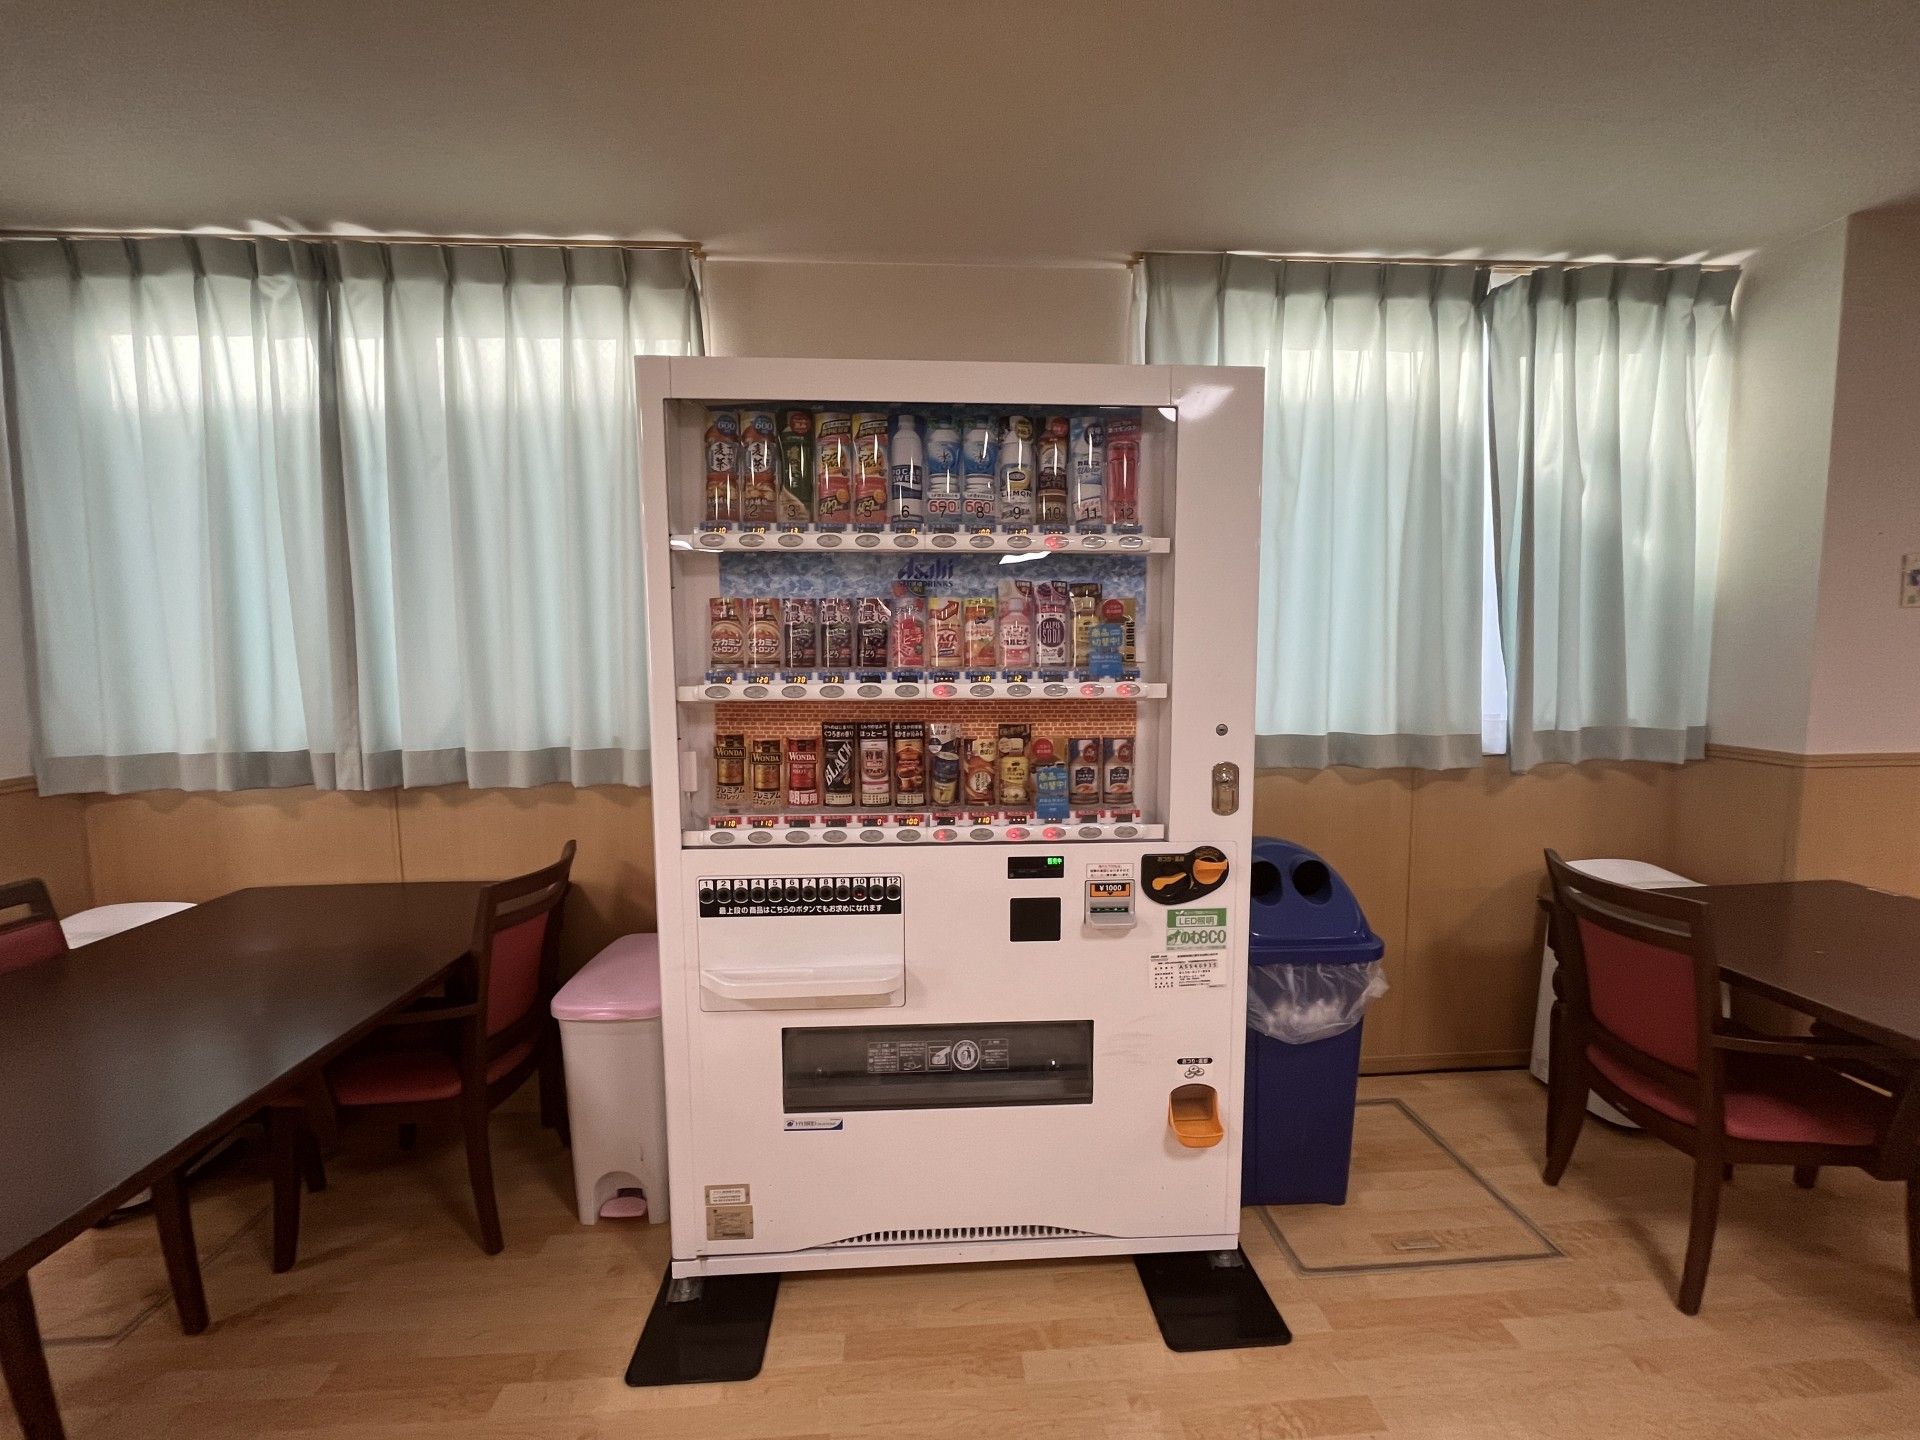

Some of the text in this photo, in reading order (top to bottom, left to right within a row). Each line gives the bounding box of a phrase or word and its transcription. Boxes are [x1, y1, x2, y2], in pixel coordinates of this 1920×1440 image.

[750, 504, 758, 517] 2
[787, 504, 796, 518] 3
[864, 507, 872, 518] 5
[901, 505, 910, 518] 6
[976, 506, 985, 519] 8
[1013, 506, 1021, 520] 9
[1046, 506, 1061, 520] 10
[1084, 507, 1097, 520] 11
[1120, 507, 1135, 520] 12
[715, 747, 743, 757] WONDA
[752, 752, 780, 762] WONDA
[788, 751, 816, 761] WONDA
[825, 741, 854, 786] BLACK
[1099, 884, 1122, 892] ¥1000
[1179, 916, 1215, 926] LED照明
[1180, 930, 1226, 945] のむeco
